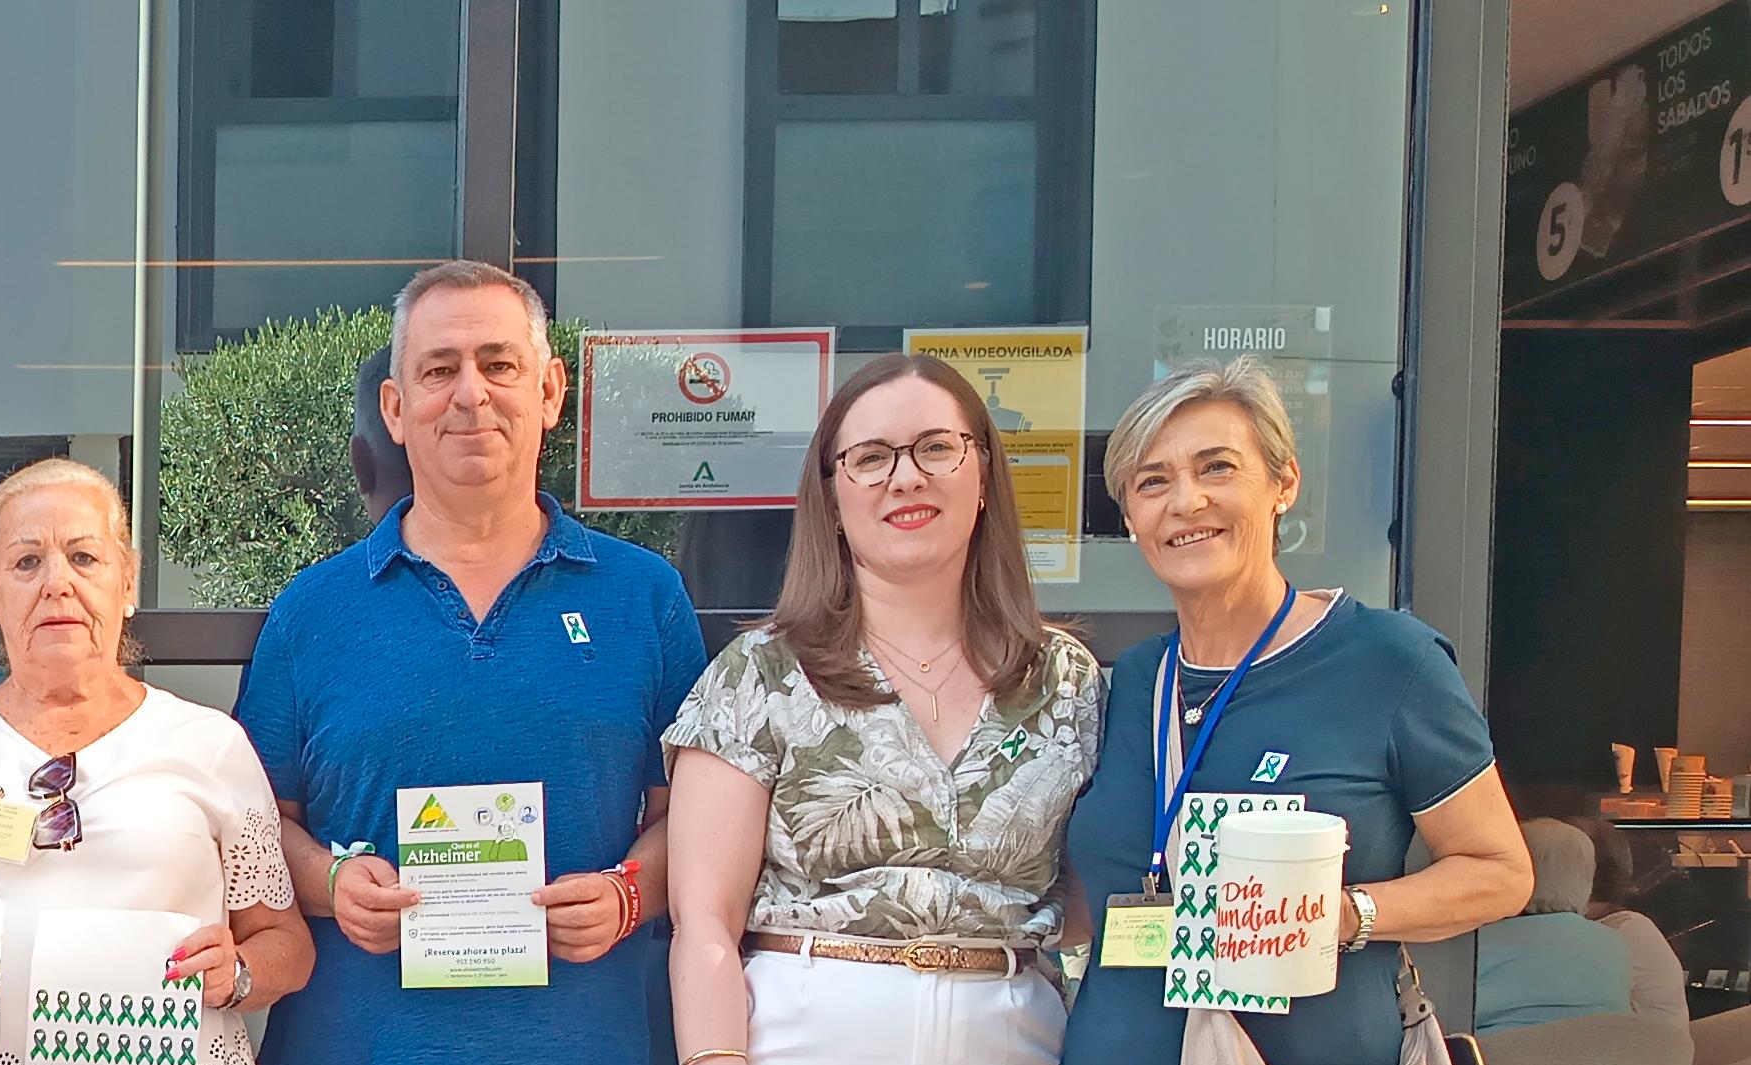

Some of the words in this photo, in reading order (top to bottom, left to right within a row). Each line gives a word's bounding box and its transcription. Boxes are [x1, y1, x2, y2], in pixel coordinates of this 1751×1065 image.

[1658, 26, 1711, 72] TODOS
[1659, 70, 1685, 103] LOS
[1204, 327, 1286, 350] HORARIO
[918, 348, 959, 358] ZONA
[963, 346, 1073, 358] VIDEOVIGILADA
[652, 412, 712, 422] PROHIBIDO
[716, 411, 755, 422] FUMAR
[406, 849, 481, 865] Alzheimer
[1222, 875, 1265, 902] Día
[1295, 894, 1325, 920] del
[463, 947, 486, 955] ahora
[1216, 927, 1310, 962] lzheimer
